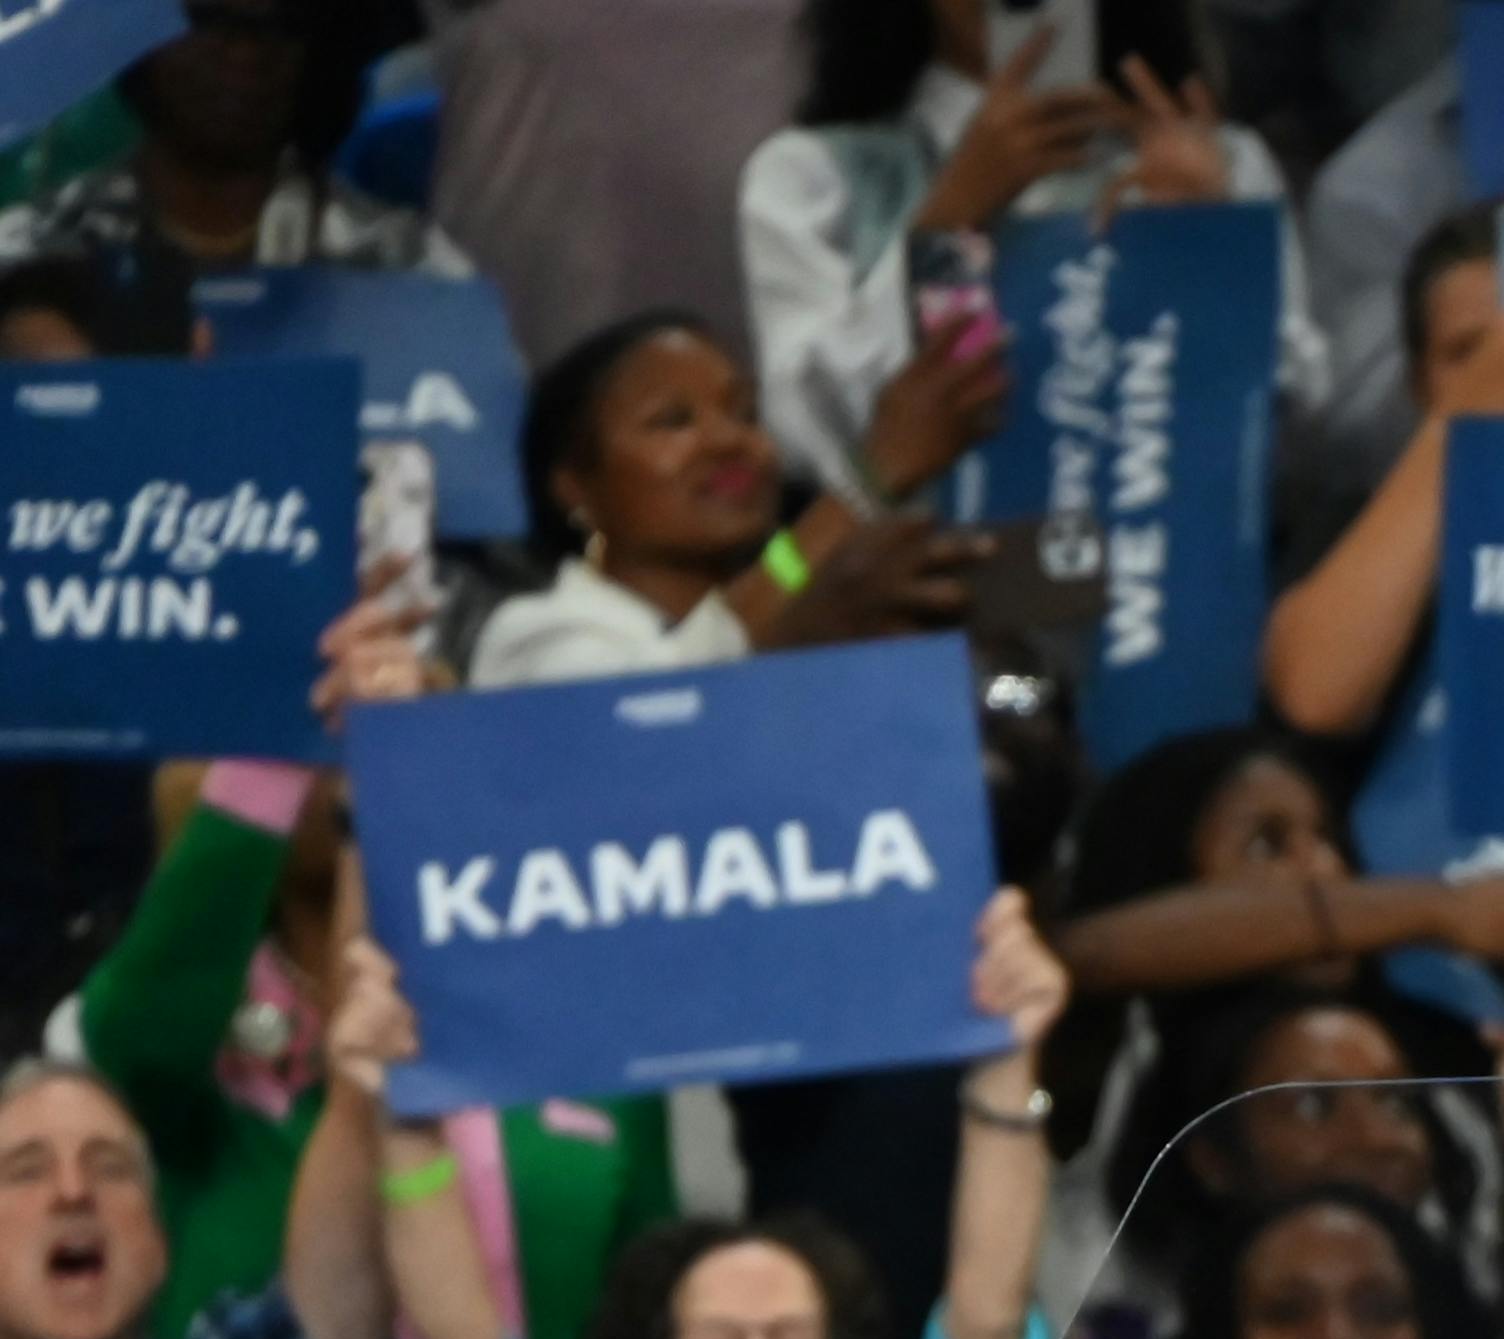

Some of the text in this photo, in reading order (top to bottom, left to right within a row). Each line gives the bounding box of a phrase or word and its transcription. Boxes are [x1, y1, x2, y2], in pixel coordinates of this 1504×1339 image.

[10, 482, 319, 567] we fight,
[1104, 311, 1178, 666] WE WIN.
[26, 577, 238, 638] WIN.
[418, 810, 936, 943] KAMALA
